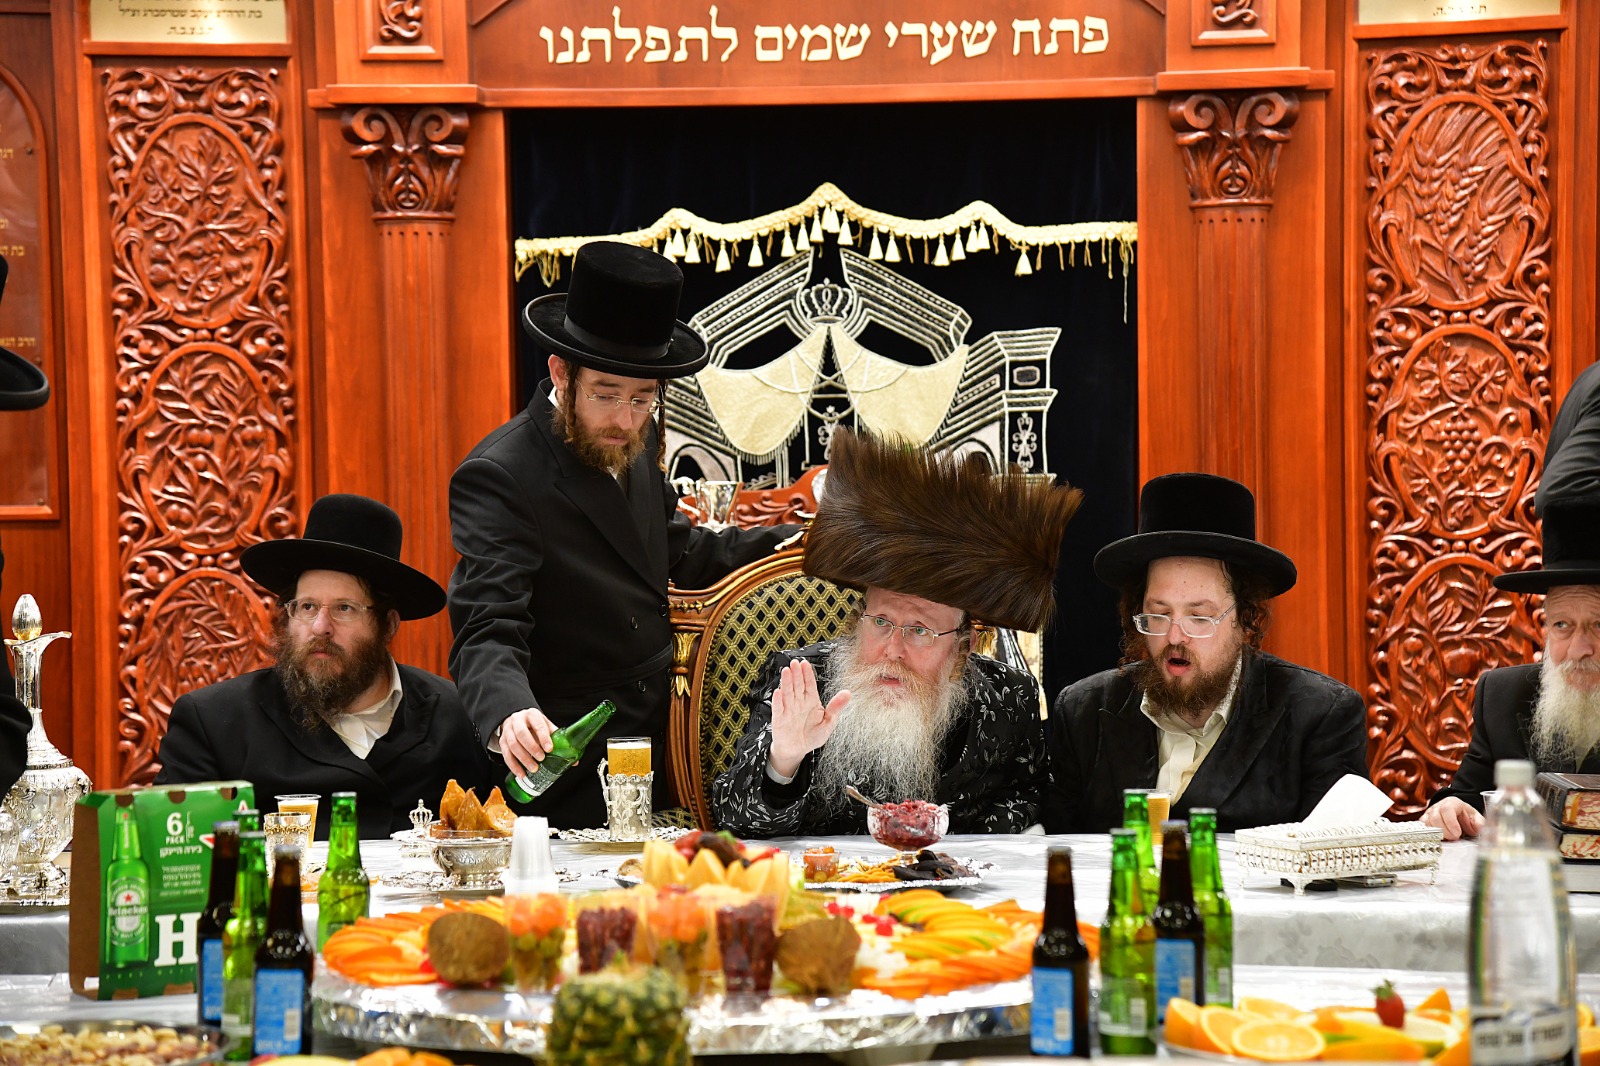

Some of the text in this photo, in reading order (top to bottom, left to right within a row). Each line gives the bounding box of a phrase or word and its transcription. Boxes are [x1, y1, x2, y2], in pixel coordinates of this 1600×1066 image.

[539, 5, 1109, 64] פתח שערי שמים לתפלתנו
[166, 812, 183, 836] 6
[165, 835, 185, 845] PACK
